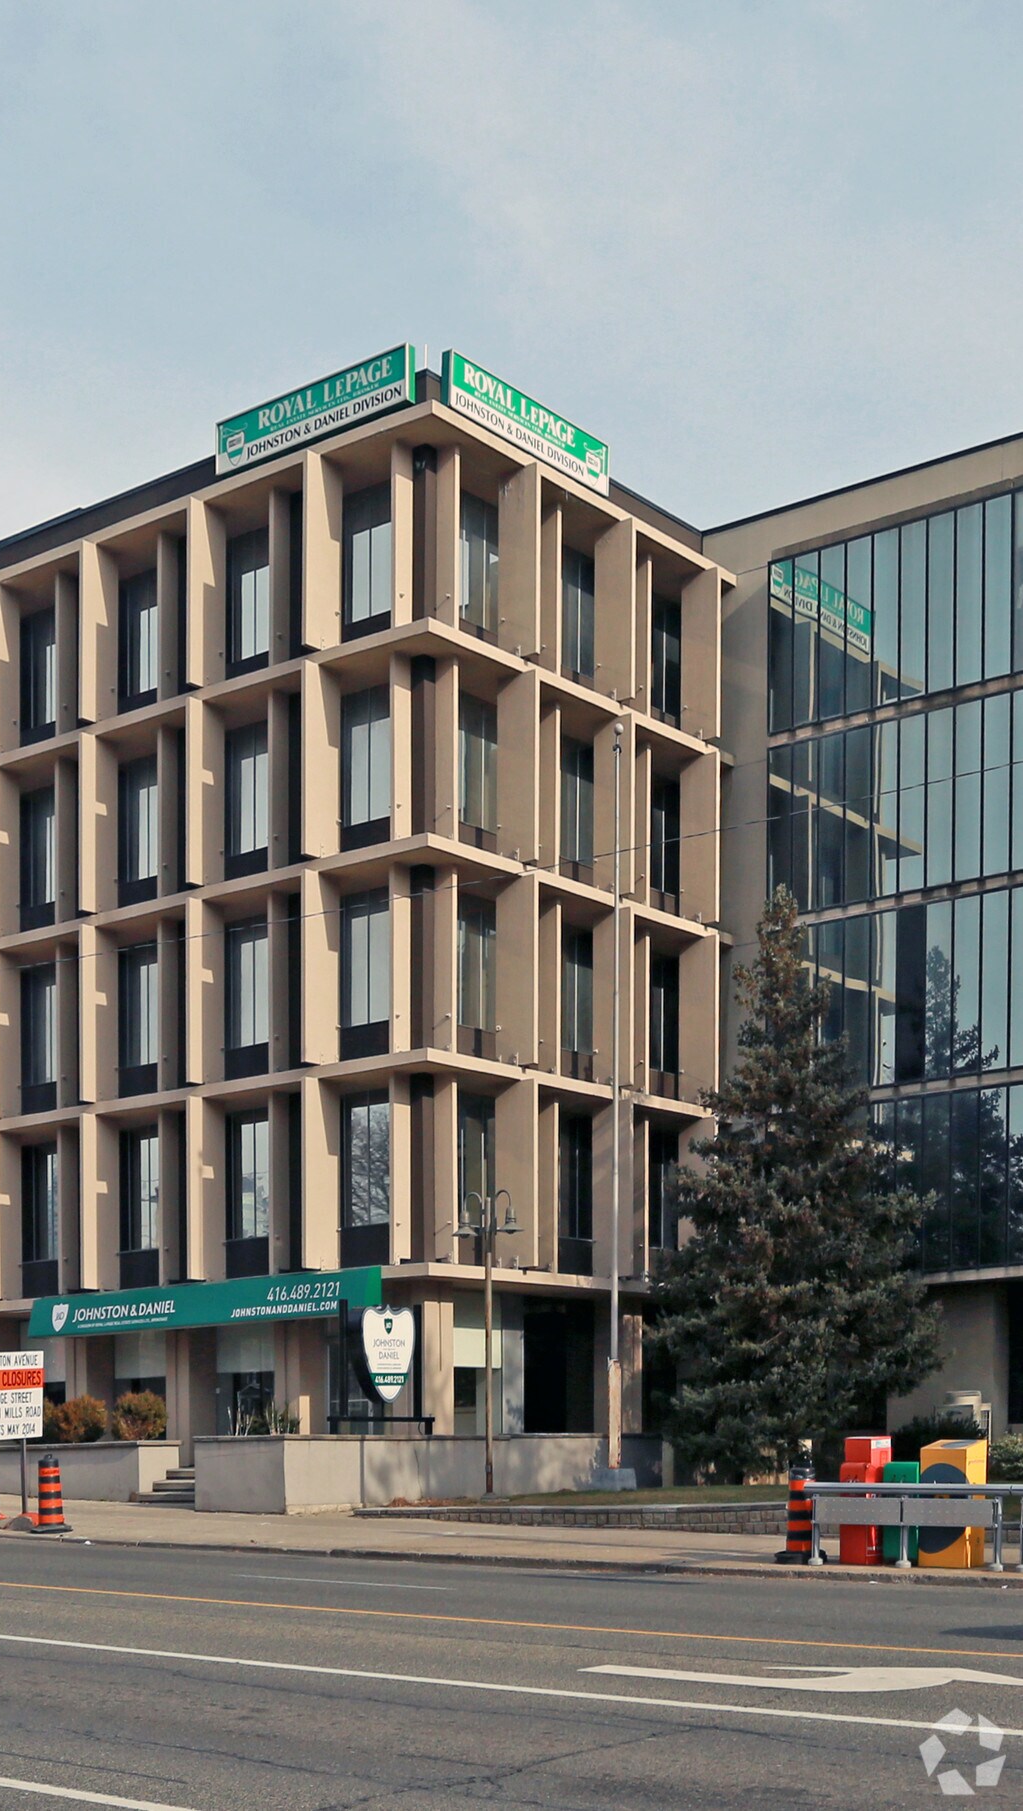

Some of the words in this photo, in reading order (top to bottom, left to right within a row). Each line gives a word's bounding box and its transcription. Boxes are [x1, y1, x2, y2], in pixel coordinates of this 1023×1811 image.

[258, 389, 316, 430] ROYAL
[324, 356, 393, 402] LEPAGE
[464, 362, 516, 412] ROYAL
[520, 398, 576, 448] LEPAGE
[246, 426, 301, 460] JOHNSTON
[303, 423, 312, 434] &
[314, 407, 350, 431] DANIEL
[353, 385, 402, 414] DIVISION
[455, 392, 504, 430] JOHNSTON
[507, 424, 513, 435] &
[515, 428, 544, 454] DANIEL
[547, 446, 584, 477] DIVISION
[267, 1281, 341, 1302] 416.489.2121
[72, 1305, 130, 1323] JOHNSTON
[130, 1304, 137, 1316] &
[139, 1300, 176, 1315] DANIEL
[230, 1301, 338, 1318] JOHNSTONANDDANIEL.COM
[373, 1339, 405, 1348] JOHNSTON
[14, 1354, 38, 1366] AVENUE
[378, 1352, 400, 1360] DANIEL
[2, 1371, 41, 1386] CLOSURES
[11, 1392, 32, 1403] STREET
[5, 1407, 23, 1418] MILLS
[26, 1406, 41, 1417] ROAD
[7, 1424, 20, 1435] MAY
[22, 1423, 36, 1435] 2014
